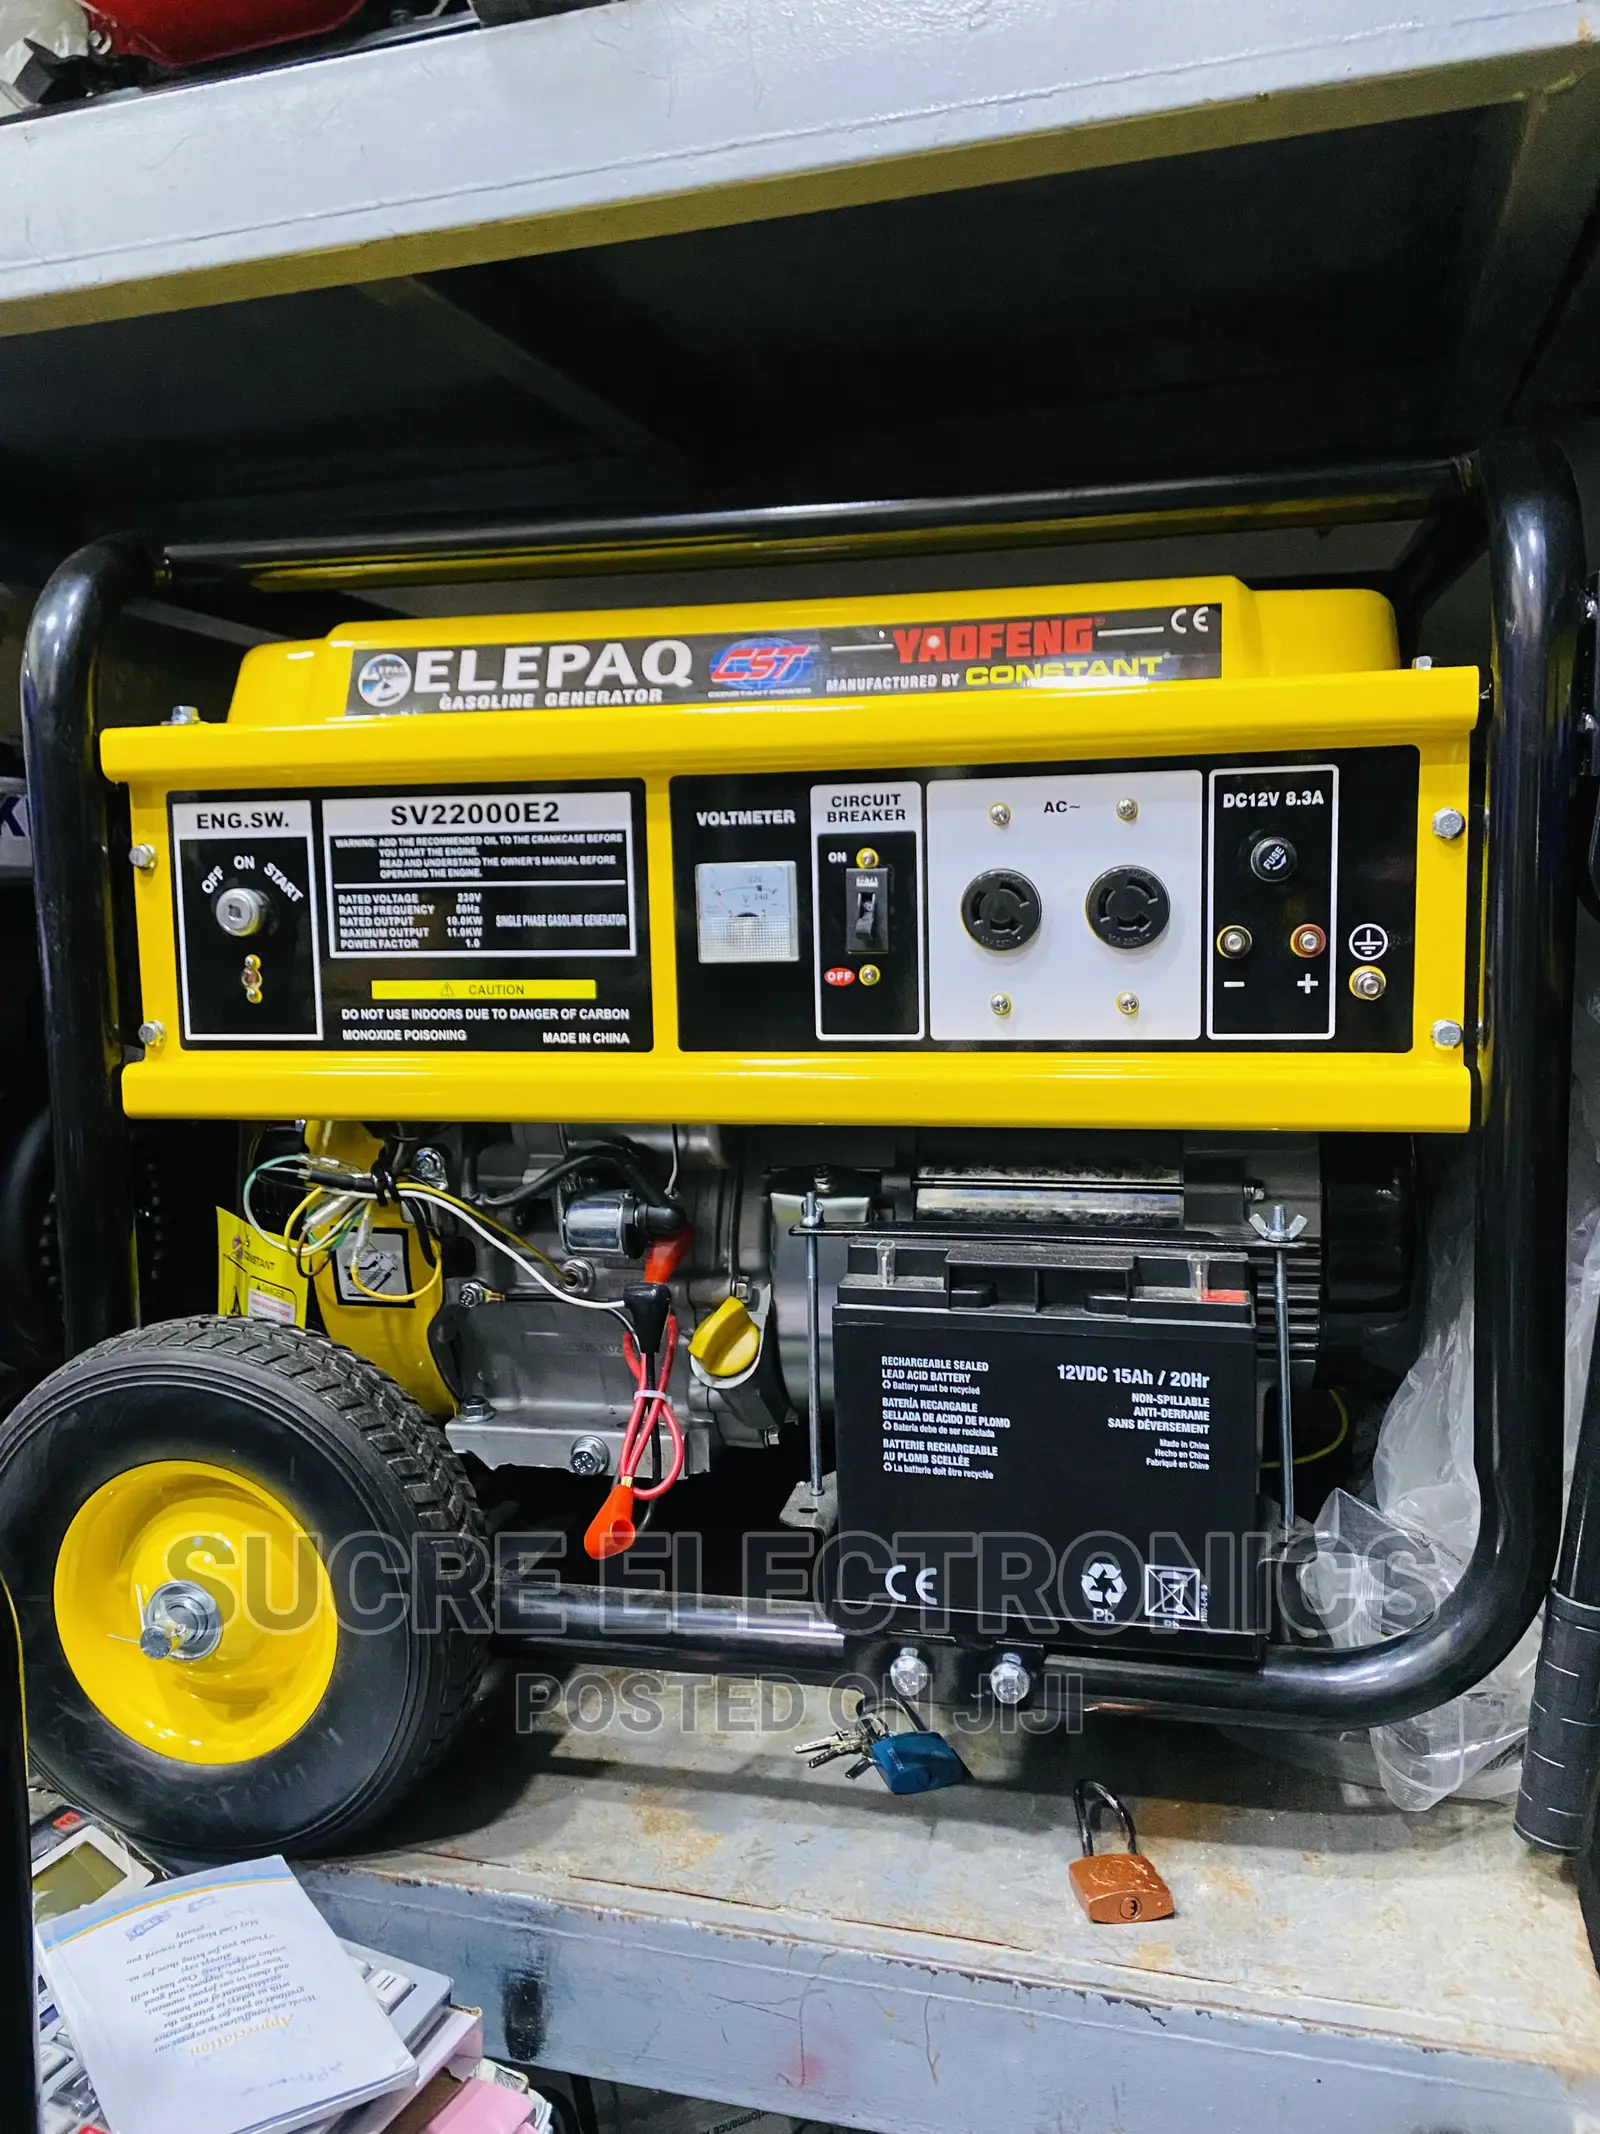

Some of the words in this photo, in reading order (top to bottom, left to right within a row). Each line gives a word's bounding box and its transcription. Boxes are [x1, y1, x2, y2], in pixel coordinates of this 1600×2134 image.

[413, 640, 694, 694] ELEPAQ
[711, 644, 810, 684] CST
[826, 673, 938, 693] MANUFACTURED
[940, 672, 960, 688] BY
[965, 655, 1163, 687] CONSTANT
[439, 692, 535, 711] GASOLINE
[544, 688, 663, 708] GENERATOR
[831, 794, 902, 809] CIRCUIT
[1222, 791, 1280, 809] DC12V
[1285, 790, 1325, 806] 8.3A
[196, 811, 290, 830] ENG.SW.
[390, 801, 560, 826] SV22000E2
[697, 809, 796, 827] VOLTMETER
[827, 808, 906, 823] BREAKER
[379, 838, 397, 847] ADD
[398, 837, 415, 847] THE
[416, 835, 482, 846] RECOMMENDED
[484, 835, 499, 845] OIL
[499, 835, 512, 845] TO
[513, 834, 530, 845] THE
[531, 833, 585, 845] CRANKCASE
[586, 833, 623, 843] BEFORE
[379, 848, 397, 857] YOU
[399, 848, 425, 858] START
[427, 847, 444, 857] THE
[828, 851, 848, 864] ON
[1262, 846, 1286, 872] FUSE
[233, 855, 255, 871] ON
[380, 859, 403, 868] READ
[404, 858, 422, 868] AND
[423, 857, 481, 868] UNDERSTAND
[482, 857, 499, 867] THE
[501, 856, 541, 867] OWNER'S
[542, 855, 578, 866] MANUAL
[580, 855, 616, 865] BEFORE
[201, 865, 225, 895] OFF
[380, 869, 429, 879] OPERATING
[430, 868, 446, 878] THE
[263, 861, 304, 904] START
[338, 893, 372, 904] RATED
[372, 893, 419, 904] VOLTAGE
[457, 892, 482, 904] 230V
[338, 904, 372, 916] RATED
[373, 904, 435, 916] FREQUENCY
[339, 916, 373, 927] RATED
[374, 916, 415, 927] OUTPUT
[446, 915, 483, 926] 10.0KW
[495, 914, 522, 928] SINGLE
[523, 914, 547, 928] PHASE
[547, 914, 583, 927] GASOLINE
[584, 913, 628, 927] GENERATOR
[340, 927, 388, 939] MAXIMUM
[389, 927, 430, 938] OUTPUT
[447, 927, 483, 938] 11.0KW
[340, 939, 378, 950] POWER
[379, 939, 420, 949] FACTOR
[465, 938, 481, 949] 1.0
[827, 971, 852, 983] OFF
[468, 984, 525, 997] CAUTION
[341, 1008, 361, 1022] DO
[362, 1008, 385, 1022] NOT
[386, 1008, 410, 1022] USE
[411, 1008, 464, 1022] INDOORS
[465, 1008, 489, 1022] DUE
[490, 1008, 508, 1022] TO
[509, 1008, 559, 1022] DANGER
[561, 1008, 577, 1022] OF
[579, 1008, 630, 1022] CARBON
[342, 1029, 402, 1043] MONOXIDE
[403, 1029, 467, 1043] POISONING
[543, 1031, 576, 1044] MADE
[578, 1031, 592, 1044] IN
[593, 1031, 630, 1045] CHINA
[882, 1355, 952, 1370] RECHARGEABLE
[954, 1360, 989, 1372] SEALED
[882, 1368, 905, 1379] LEAD
[907, 1370, 928, 1381] ACID
[930, 1371, 971, 1383] BATTERY
[1057, 1364, 1108, 1382] 12VDC
[1112, 1367, 1154, 1385] 15Ah
[1157, 1370, 1166, 1386] /
[1170, 1371, 1210, 1389] 20Hr
[892, 1381, 918, 1393] Battery
[920, 1383, 938, 1392] must
[939, 1384, 949, 1393] be
[950, 1385, 981, 1396] recycled
[882, 1396, 919, 1409] BATERÍA
[920, 1399, 979, 1413] RECARGABLE
[1131, 1392, 1210, 1408] NON-SPILLABLE
[882, 1409, 921, 1422] SELLADA
[922, 1411, 935, 1423] DE
[936, 1413, 963, 1425] ACIDO
[965, 1414, 978, 1426] DE
[979, 1416, 1011, 1429] PLOMO
[1133, 1406, 1210, 1421] ANTI-DERRAME
[920, 1424, 937, 1434] debe
[939, 1425, 948, 1435] de
[949, 1427, 961, 1436] ser
[962, 1428, 995, 1438] reciclada
[1107, 1417, 1135, 1430] SANS
[1137, 1418, 1210, 1435] DÉVERSEMENT
[883, 1438, 925, 1451] BATTERIE
[927, 1441, 999, 1457] RECHARGEABLE
[1159, 1438, 1180, 1449] Made
[1181, 1439, 1188, 1449] in
[1189, 1440, 1210, 1450] China
[883, 1451, 896, 1461] AU
[897, 1452, 929, 1464] PLOMB
[931, 1454, 970, 1467] SCELLÉE
[1154, 1448, 1178, 1459] Hecho
[1178, 1451, 1188, 1459] en
[1189, 1450, 1210, 1460] China
[893, 1464, 903, 1473] La
[904, 1464, 932, 1475] batterie
[932, 1466, 947, 1476] doit
[947, 1467, 963, 1477] être
[963, 1469, 994, 1480] recyclée
[1146, 1458, 1178, 1469] Fabriqué
[1178, 1460, 1188, 1469] en
[1189, 1460, 1210, 1471] Chine
[1092, 1607, 1115, 1623] Pb
[188, 2014, 295, 2057] Appreciation
